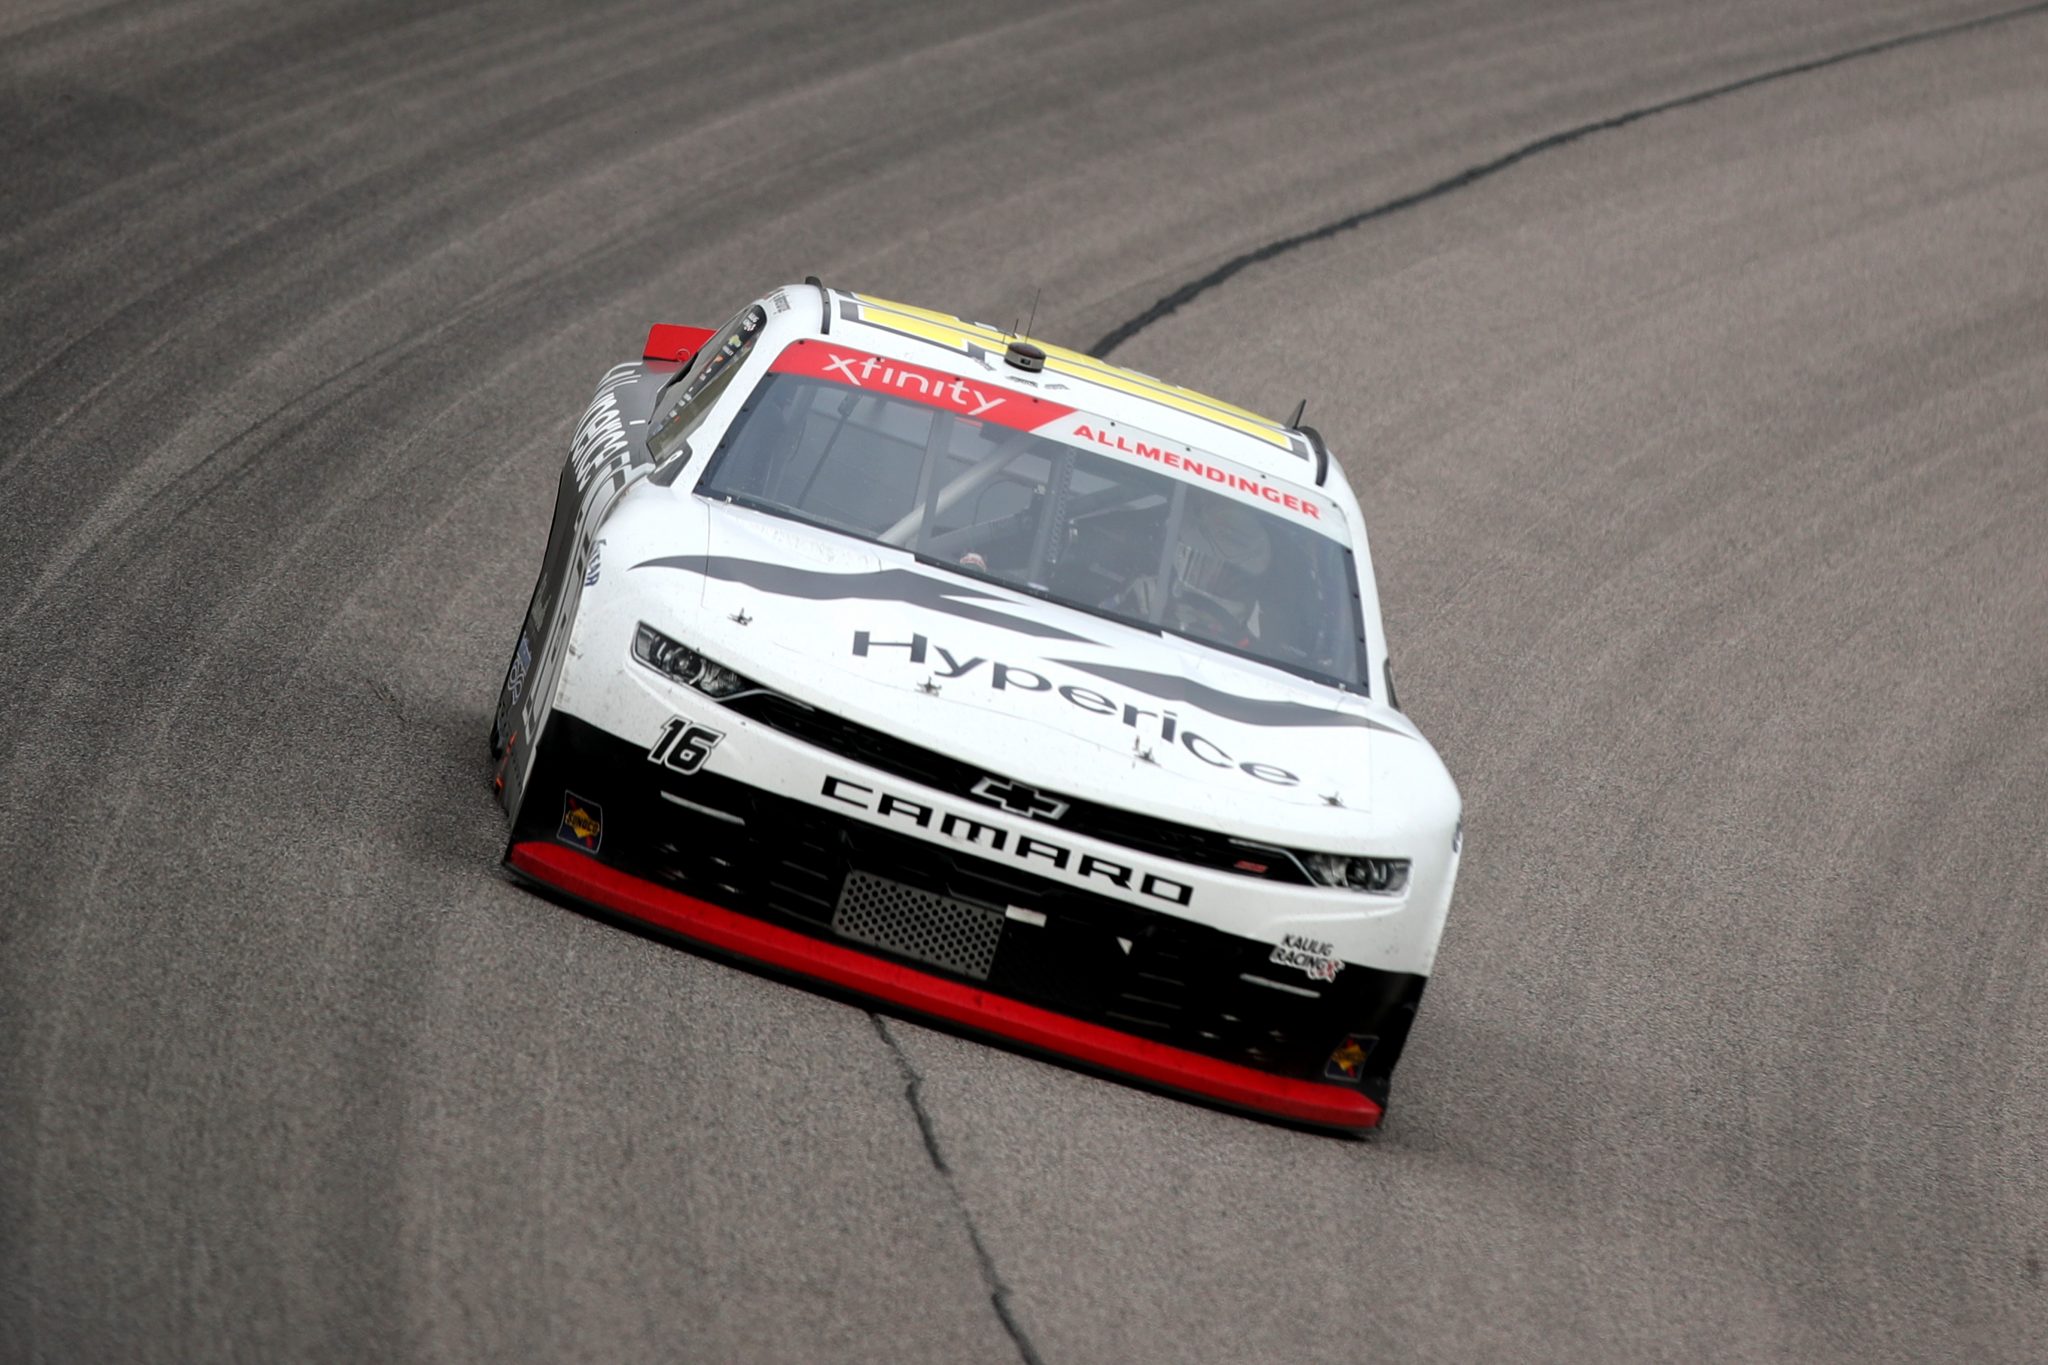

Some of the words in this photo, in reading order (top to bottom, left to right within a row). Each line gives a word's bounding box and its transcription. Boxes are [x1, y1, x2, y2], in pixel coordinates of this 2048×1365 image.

[824, 352, 1006, 416] xfinity
[1072, 424, 1320, 520] ALLMENDINGER
[852, 631, 1301, 787] Hyperice
[648, 716, 725, 774] 16
[821, 776, 1195, 906] CAMARO
[1271, 946, 1328, 971] RACING
[1281, 933, 1334, 957] KAULIG
